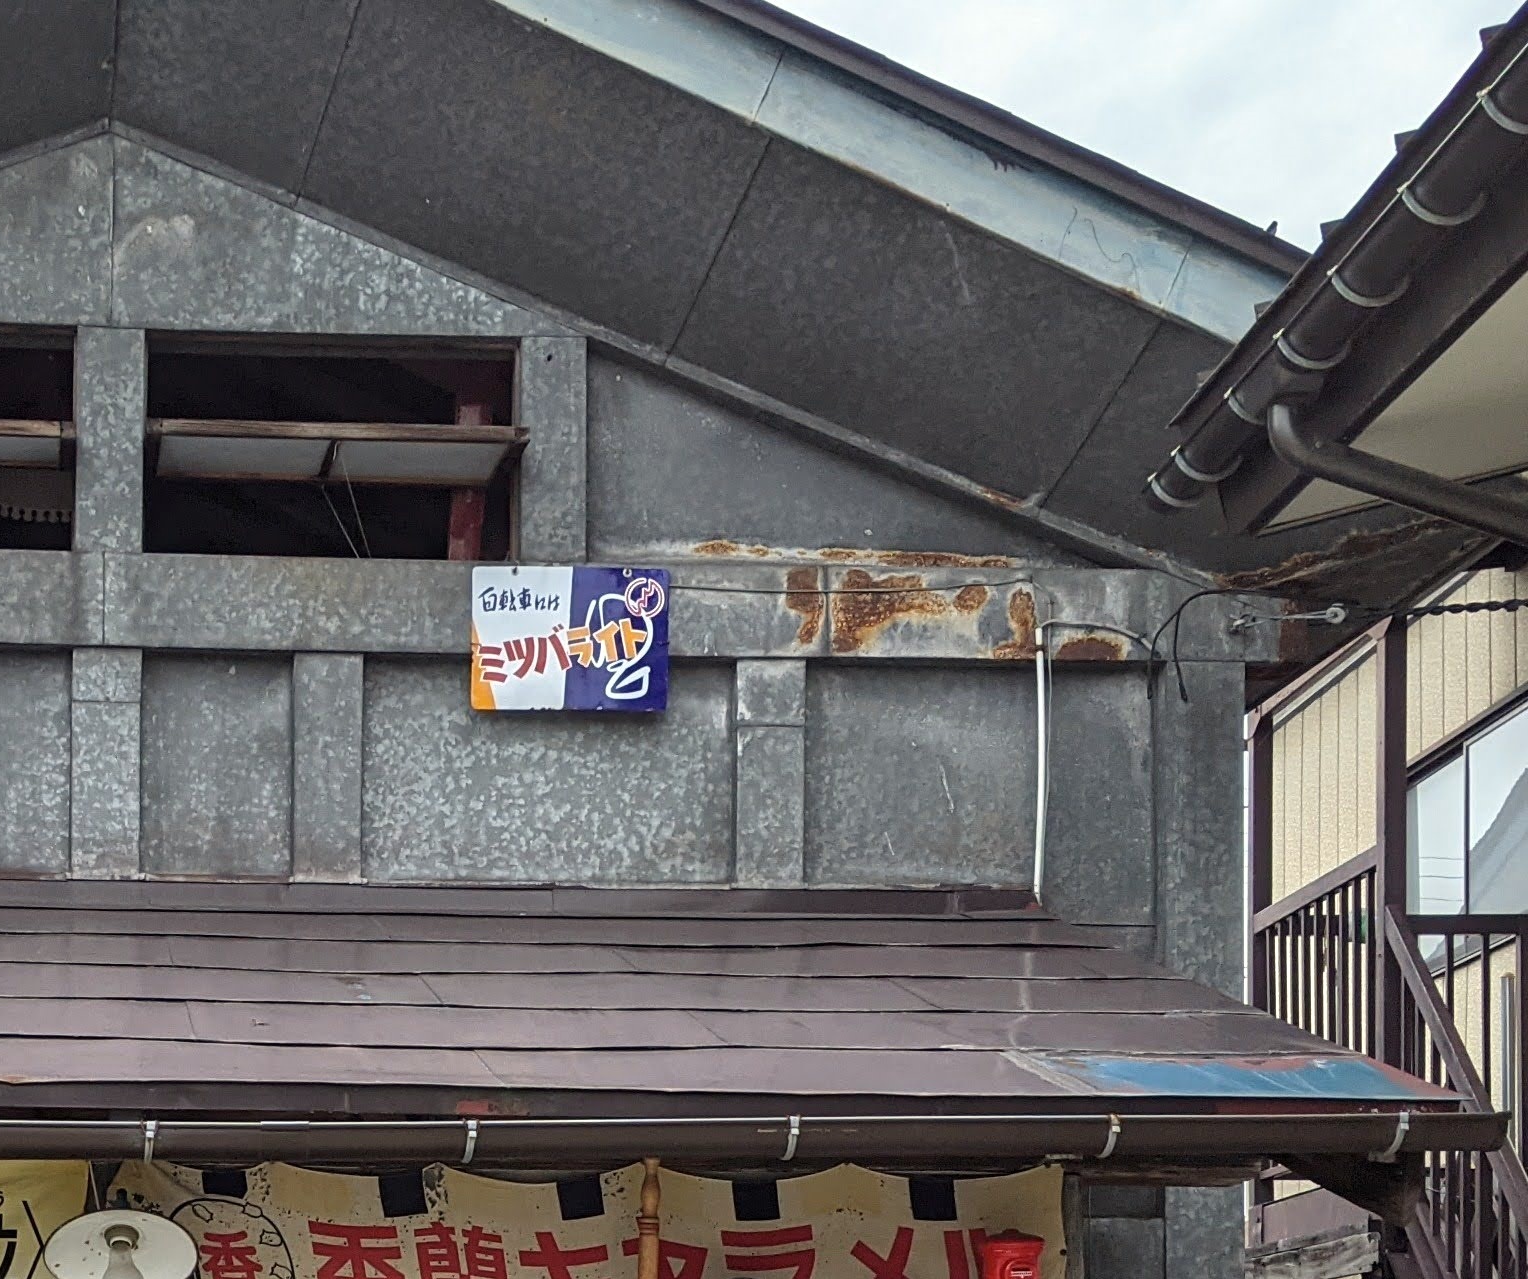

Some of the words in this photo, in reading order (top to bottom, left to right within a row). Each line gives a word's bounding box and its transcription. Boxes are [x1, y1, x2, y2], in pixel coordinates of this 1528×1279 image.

[478, 586, 561, 612] 自転車には
[478, 617, 648, 684] ミツバライト
